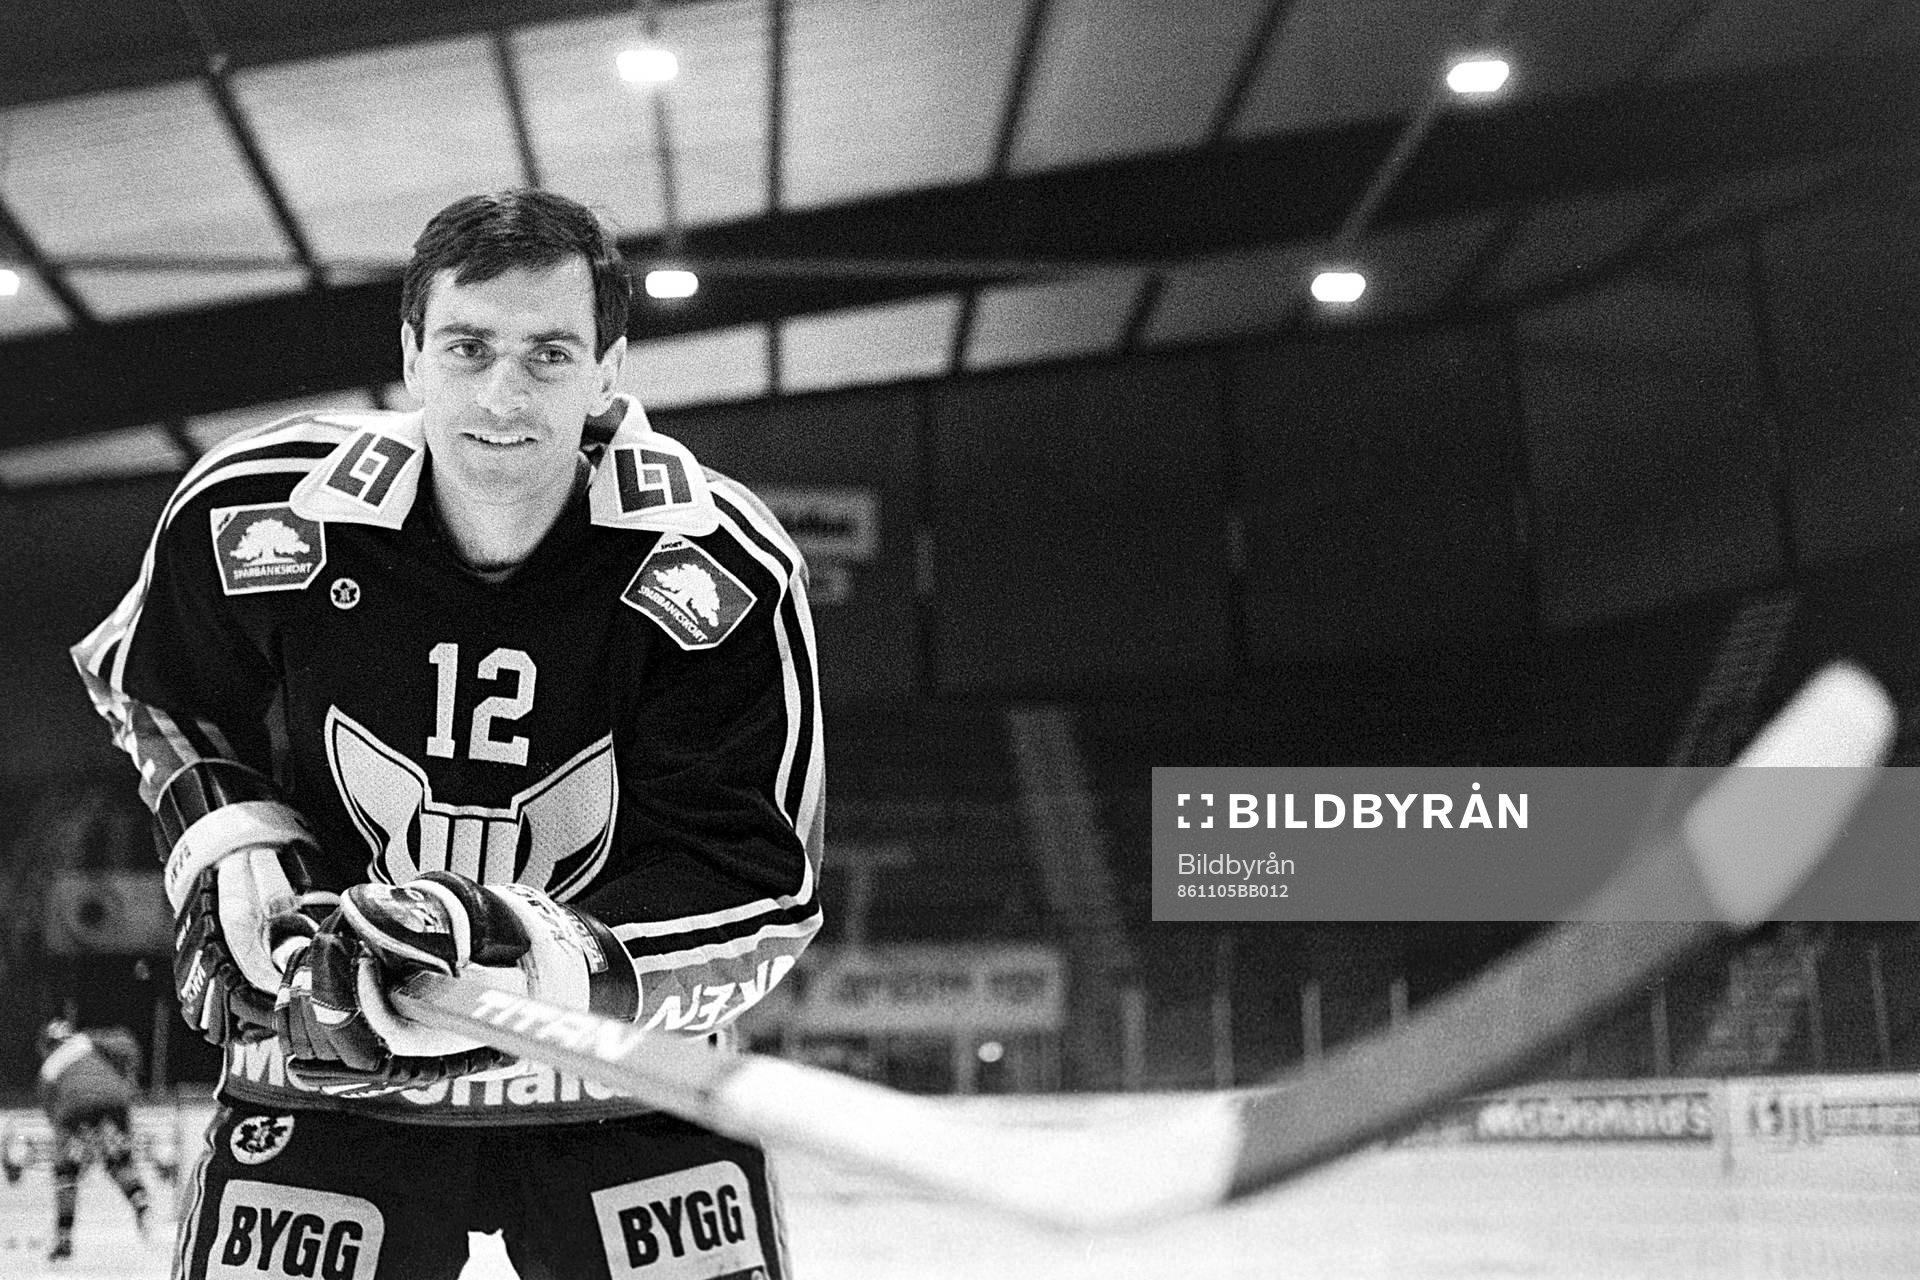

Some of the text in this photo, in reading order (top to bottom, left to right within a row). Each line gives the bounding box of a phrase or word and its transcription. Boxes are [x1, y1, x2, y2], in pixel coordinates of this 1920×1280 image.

[426, 642, 537, 767] 12
[221, 1205, 364, 1280] BYGG
[618, 1184, 746, 1270] BYGG
